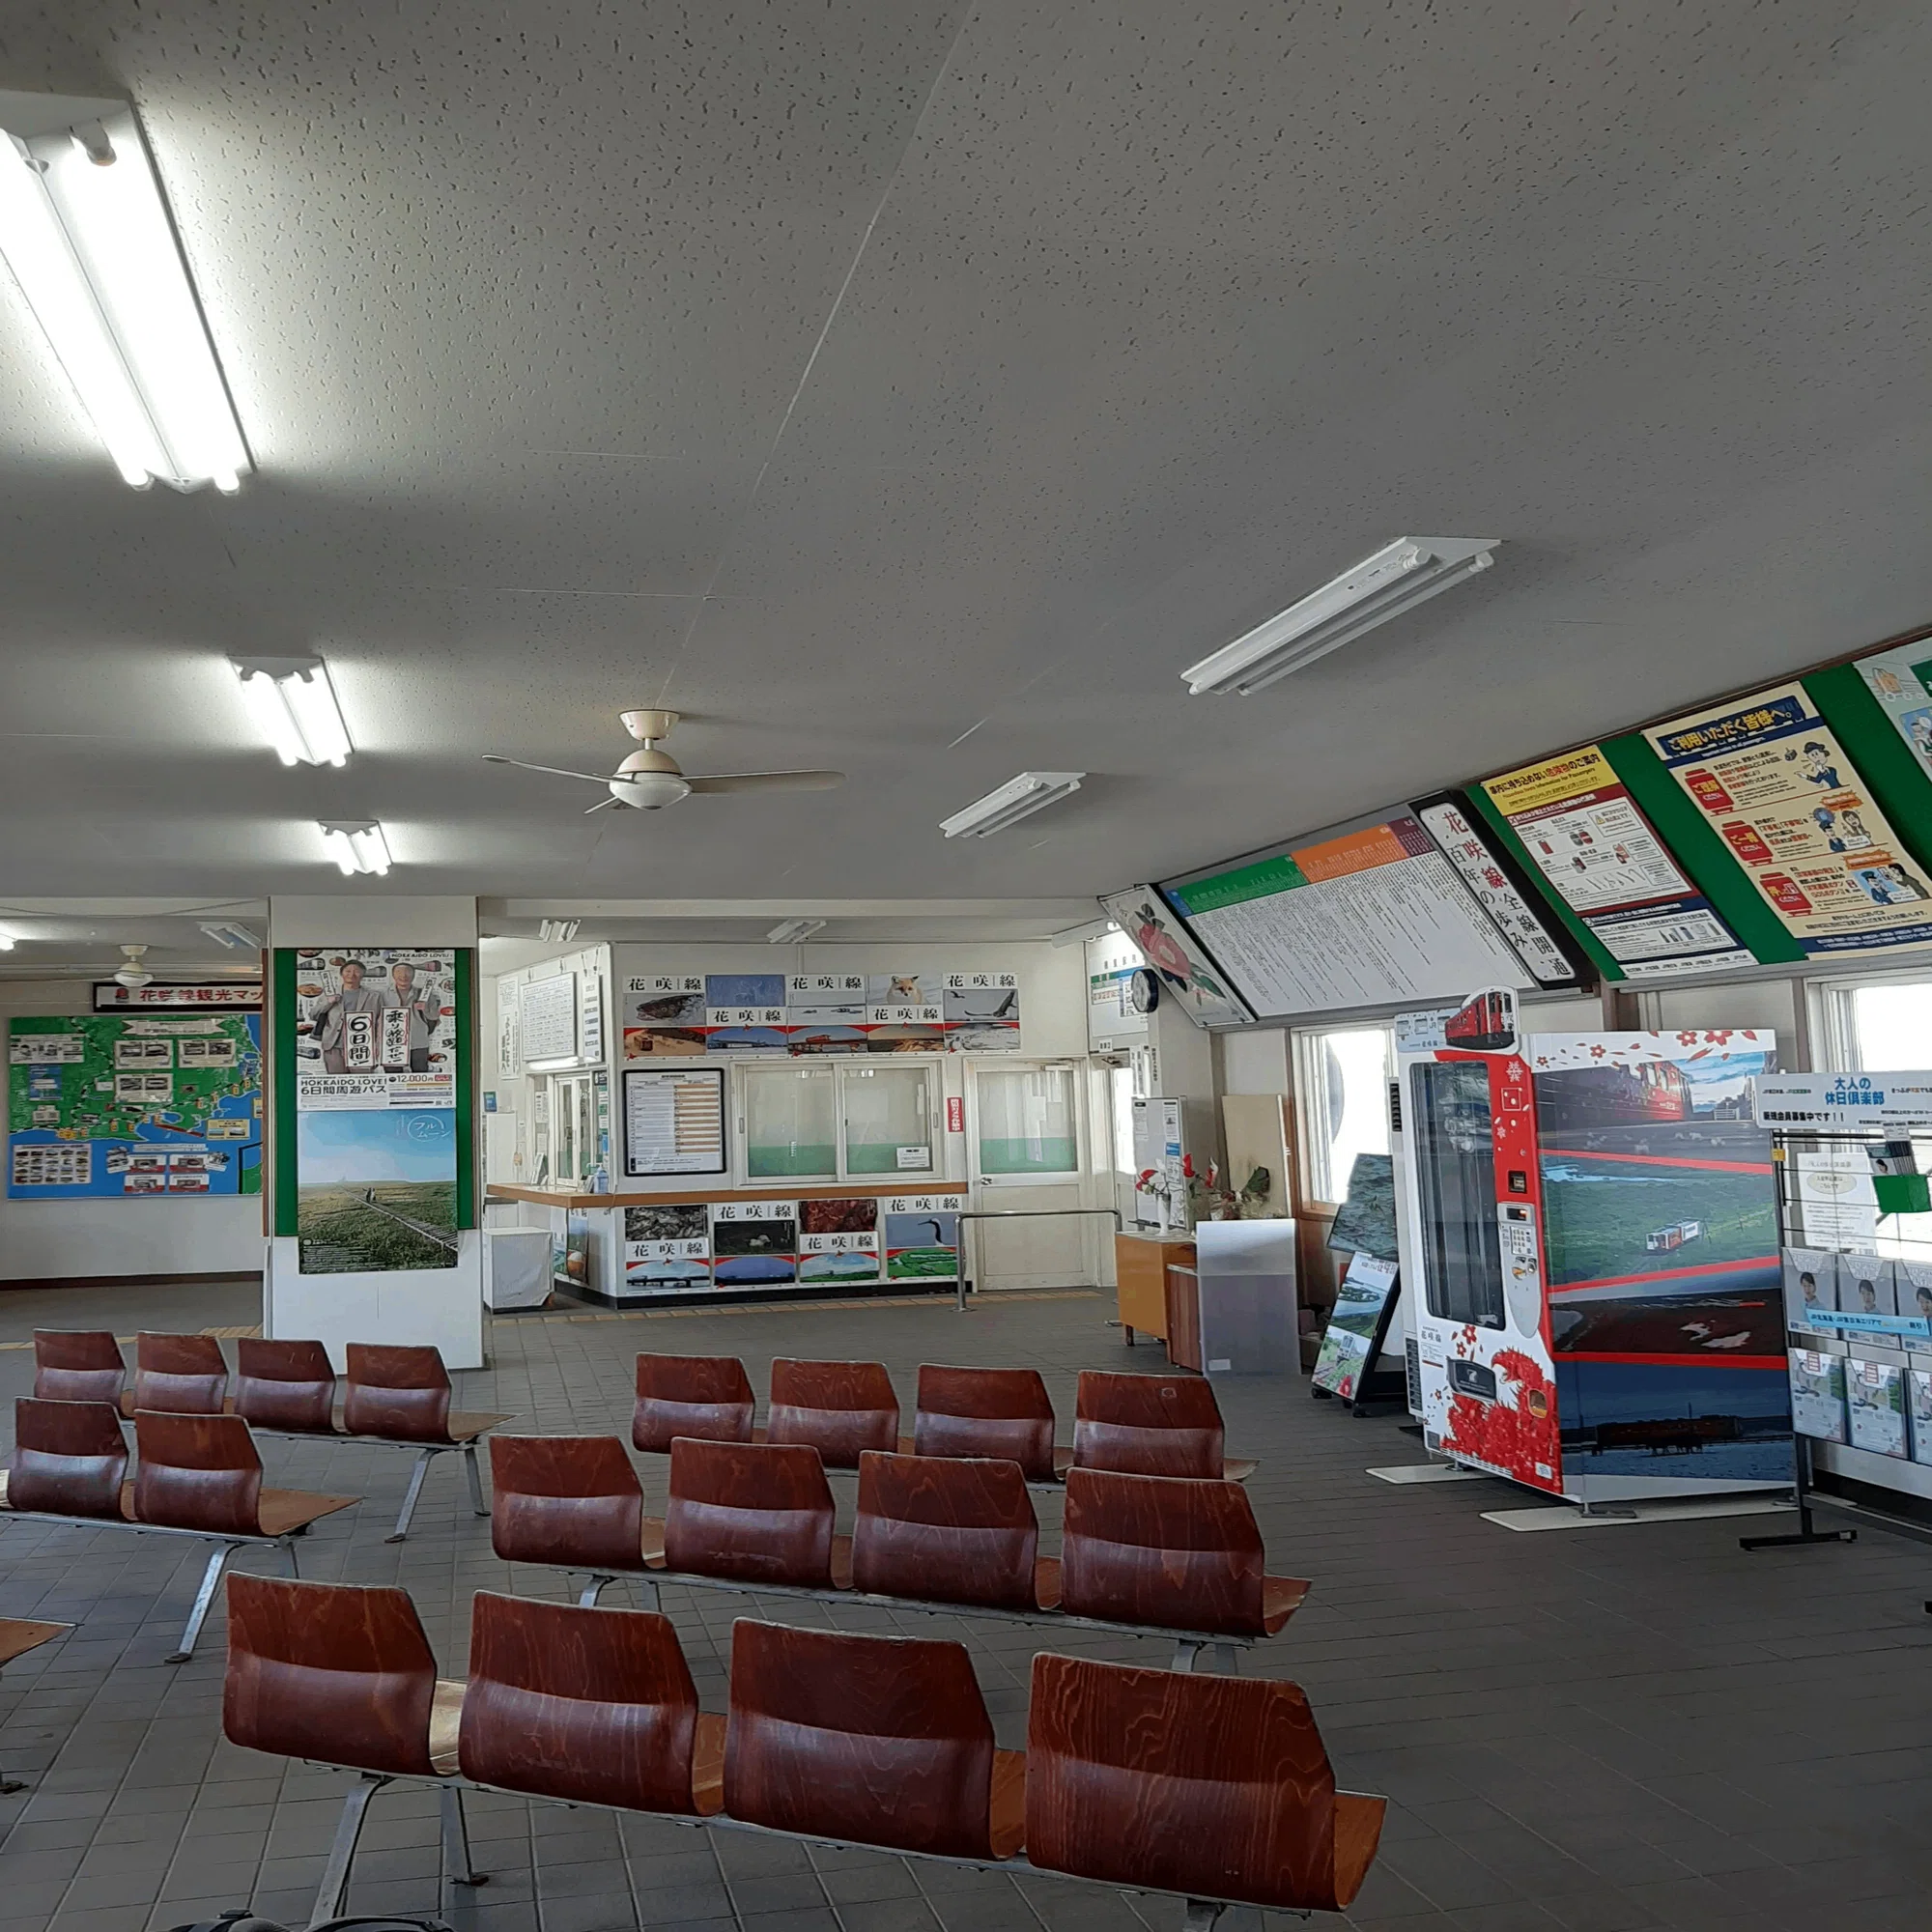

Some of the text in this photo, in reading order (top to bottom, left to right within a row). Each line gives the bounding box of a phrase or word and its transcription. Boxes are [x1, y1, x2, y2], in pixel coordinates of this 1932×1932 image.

[1668, 709, 1792, 751] ご利用いただく皆様へ。
[1447, 843, 1528, 949] 百年の歩み
[628, 977, 702, 991] 花咲線
[791, 976, 863, 990] 花咲線
[948, 974, 1015, 987] 花咲線
[714, 1009, 781, 1023] 花咲線
[874, 1008, 939, 1021] 花咲線
[300, 1078, 355, 1087] HOKKAIDO
[1834, 1077, 1871, 1091] 大人の
[300, 1085, 386, 1095] 6日間周遊パス
[1825, 1091, 1885, 1105] 休日倶楽部
[890, 1197, 959, 1212] 花咲線
[719, 1205, 792, 1219] 花咲線
[633, 1241, 704, 1258] 花咲線
[807, 1235, 874, 1250] 花咲線
